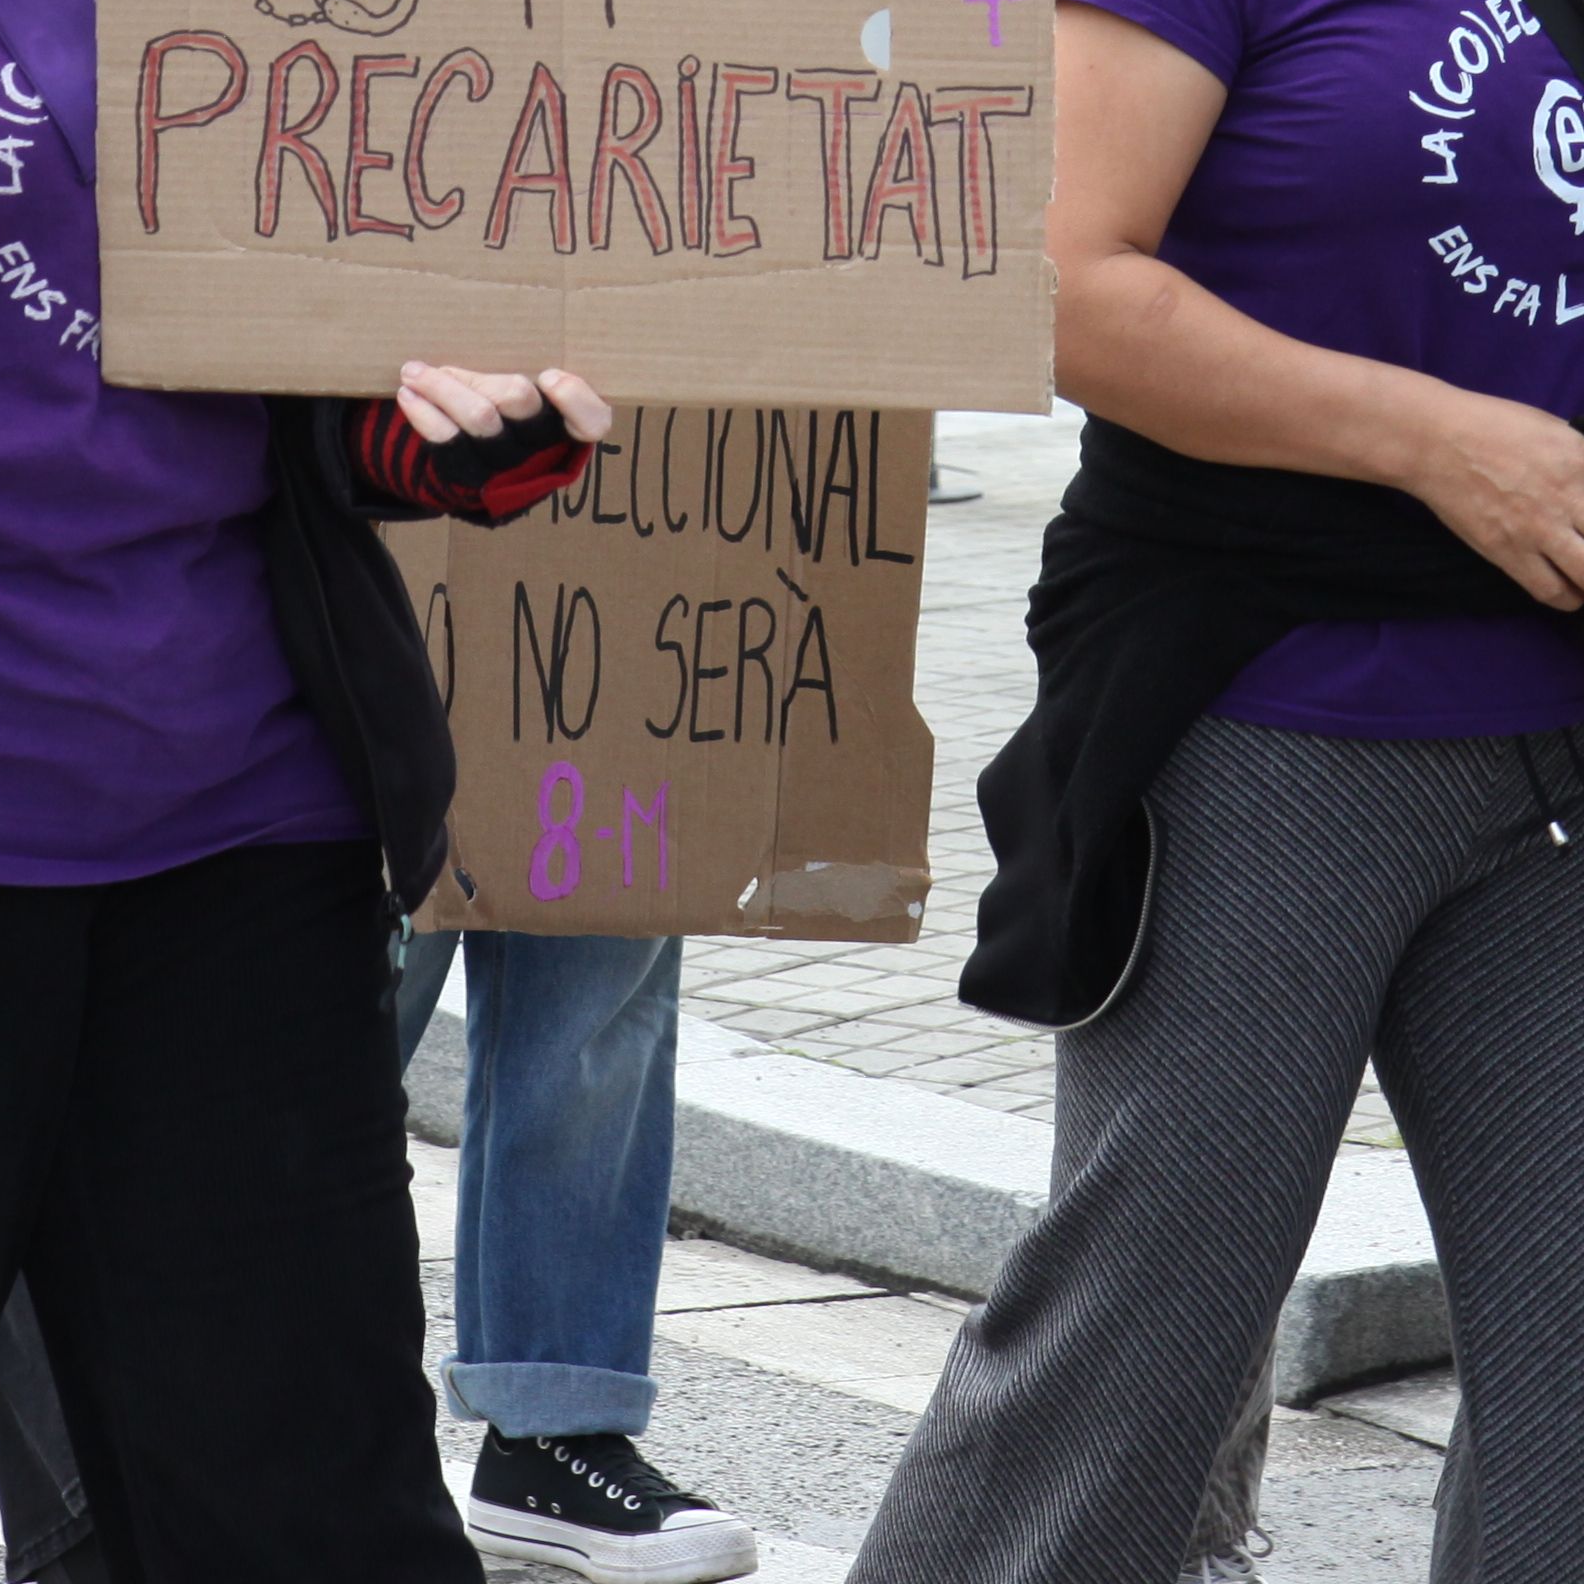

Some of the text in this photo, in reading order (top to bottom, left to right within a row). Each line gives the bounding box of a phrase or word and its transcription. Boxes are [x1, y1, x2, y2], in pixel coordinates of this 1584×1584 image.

[1421, 129, 1463, 184] LA
[1429, 225, 1499, 294] ENS
[1493, 278, 1541, 326] FA
[513, 580, 601, 743] NO
[646, 567, 839, 746] SERÀ
[529, 761, 670, 901] 8-M
